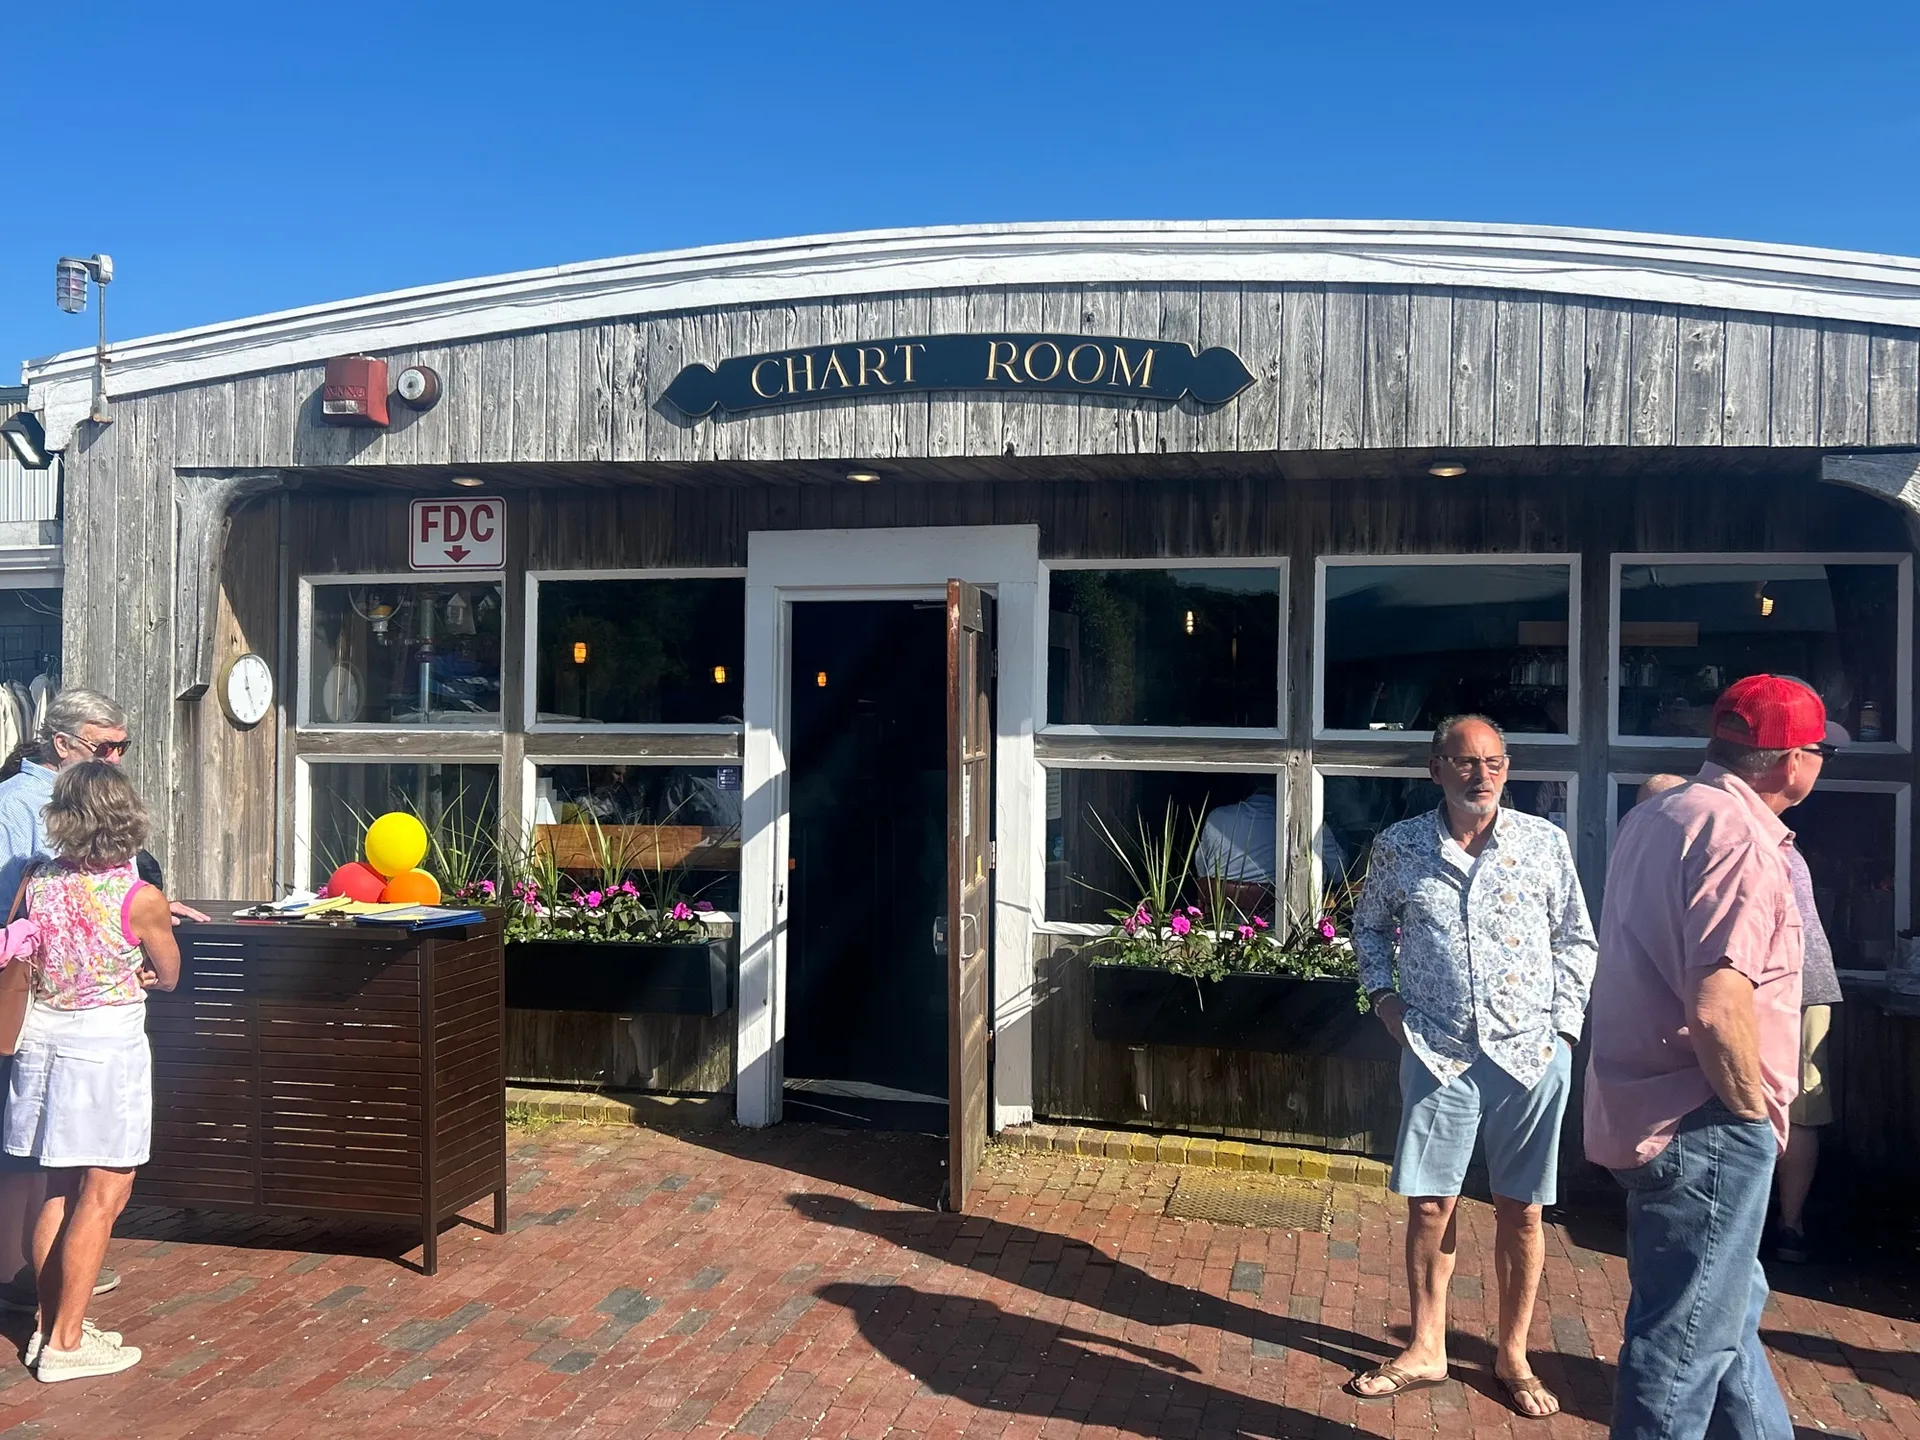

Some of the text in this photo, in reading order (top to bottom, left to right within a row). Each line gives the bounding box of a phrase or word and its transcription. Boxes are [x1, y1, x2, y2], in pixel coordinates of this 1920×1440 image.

[751, 341, 1160, 398] CHART ROOM
[420, 504, 494, 543] FDC
